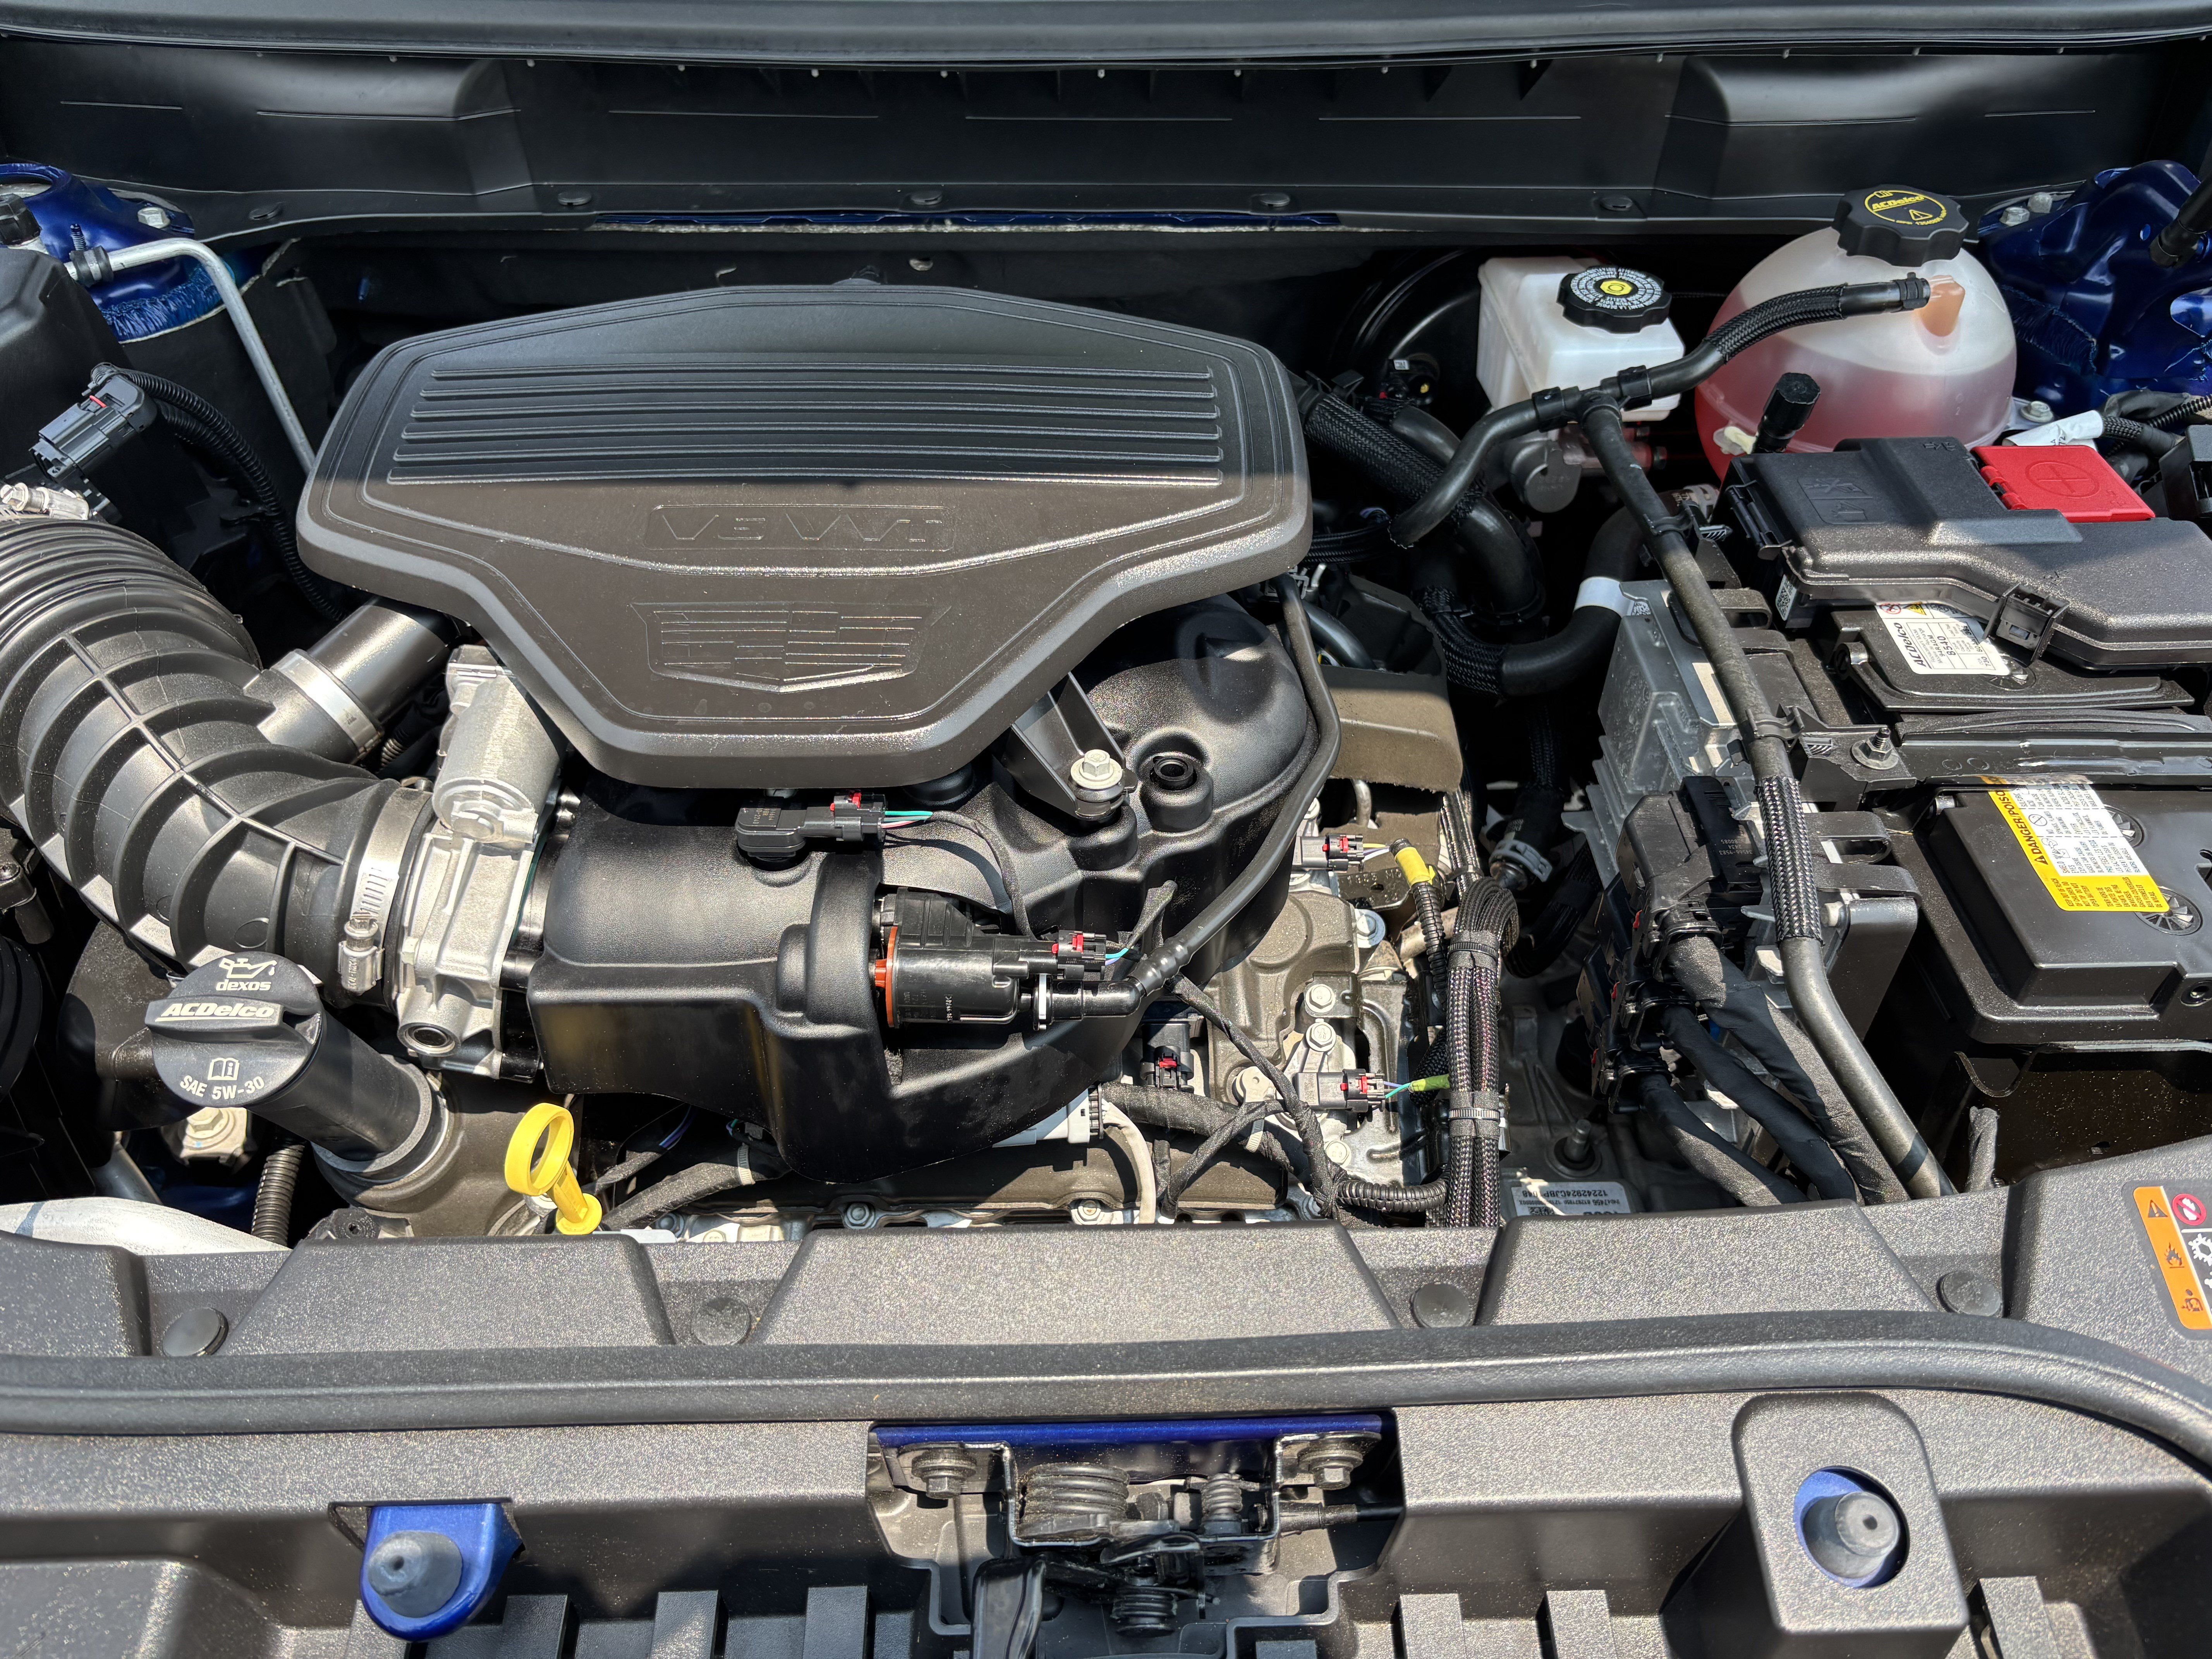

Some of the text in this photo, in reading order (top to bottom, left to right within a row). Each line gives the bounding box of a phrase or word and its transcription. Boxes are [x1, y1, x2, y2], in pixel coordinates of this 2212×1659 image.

[1872, 196, 1924, 210] ACDelco
[1893, 622, 1927, 667] ACDelco
[1937, 636, 1956, 656] 8540
[1981, 656, 1991, 667] 730
[1995, 790, 2043, 854] DANGER/POISO
[216, 978, 271, 991] dexos
[160, 1002, 275, 1018] ACDelco
[180, 1075, 264, 1100] SAE 5W-30
